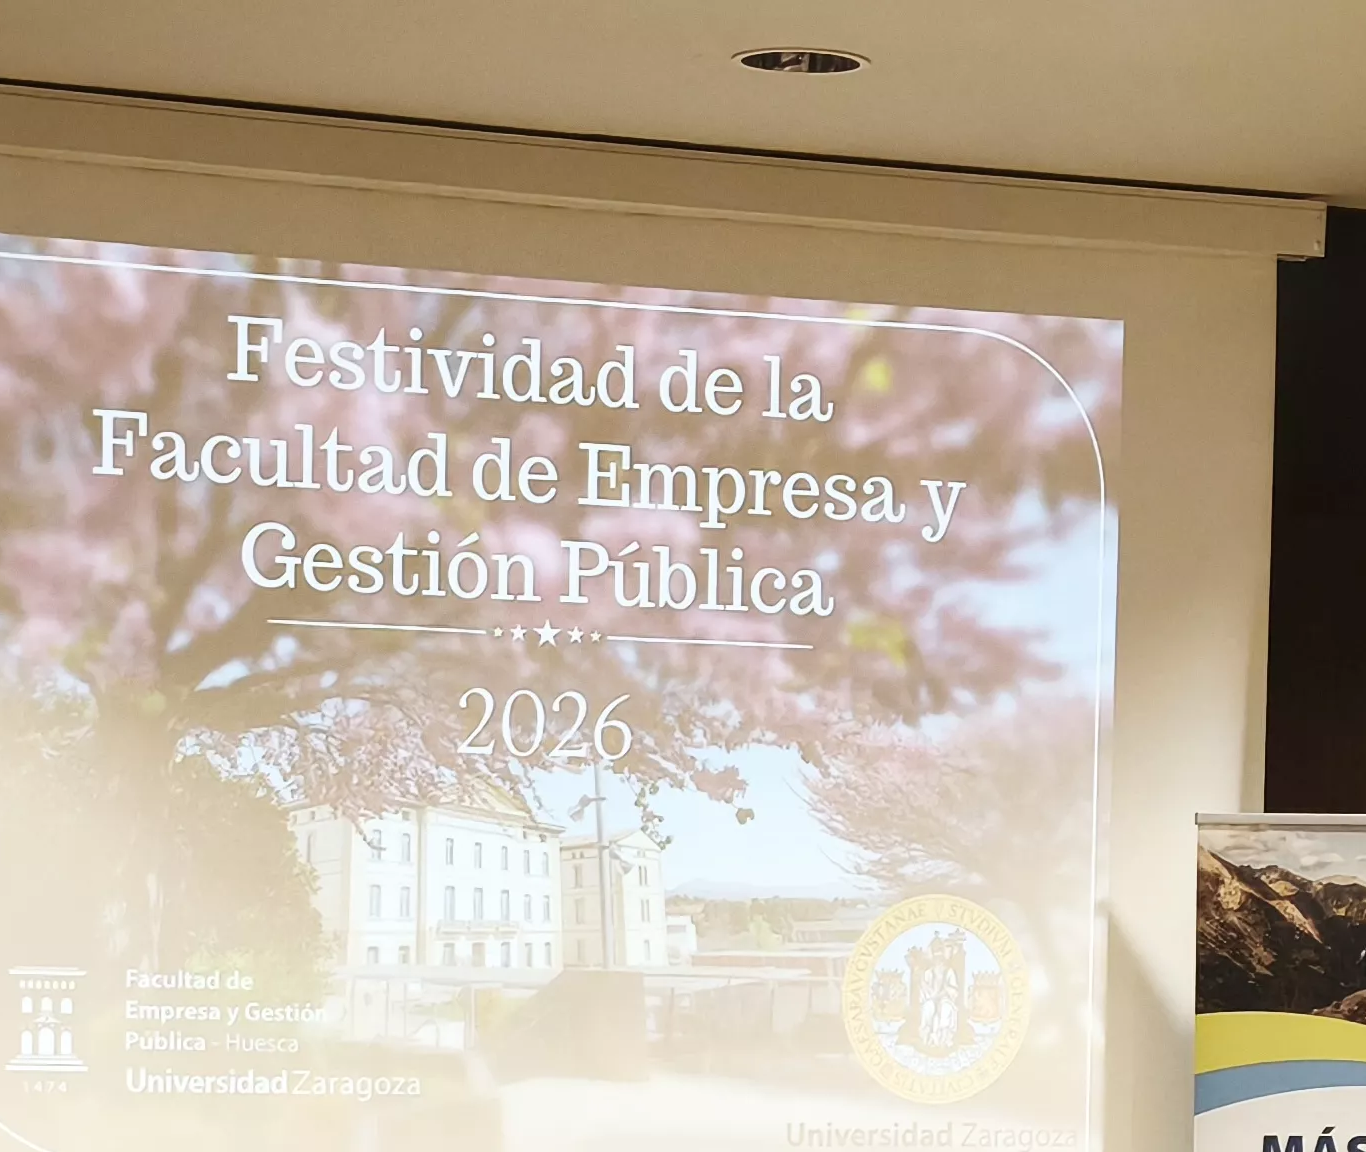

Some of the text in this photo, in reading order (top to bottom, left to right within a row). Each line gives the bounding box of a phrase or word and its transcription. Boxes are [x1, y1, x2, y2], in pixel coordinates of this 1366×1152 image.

[227, 315, 834, 422] Festividad de la
[92, 408, 967, 543] Facultad de Empresa y
[241, 521, 834, 617] Gestión Pública
[457, 688, 633, 760] 2026
[125, 969, 254, 991] Facultad de
[125, 1001, 326, 1026] Empresa y Gestión
[125, 1030, 206, 1052] Pública
[125, 1067, 422, 1102] Universidad Zaragoza
[786, 1122, 953, 1148] Universidad
